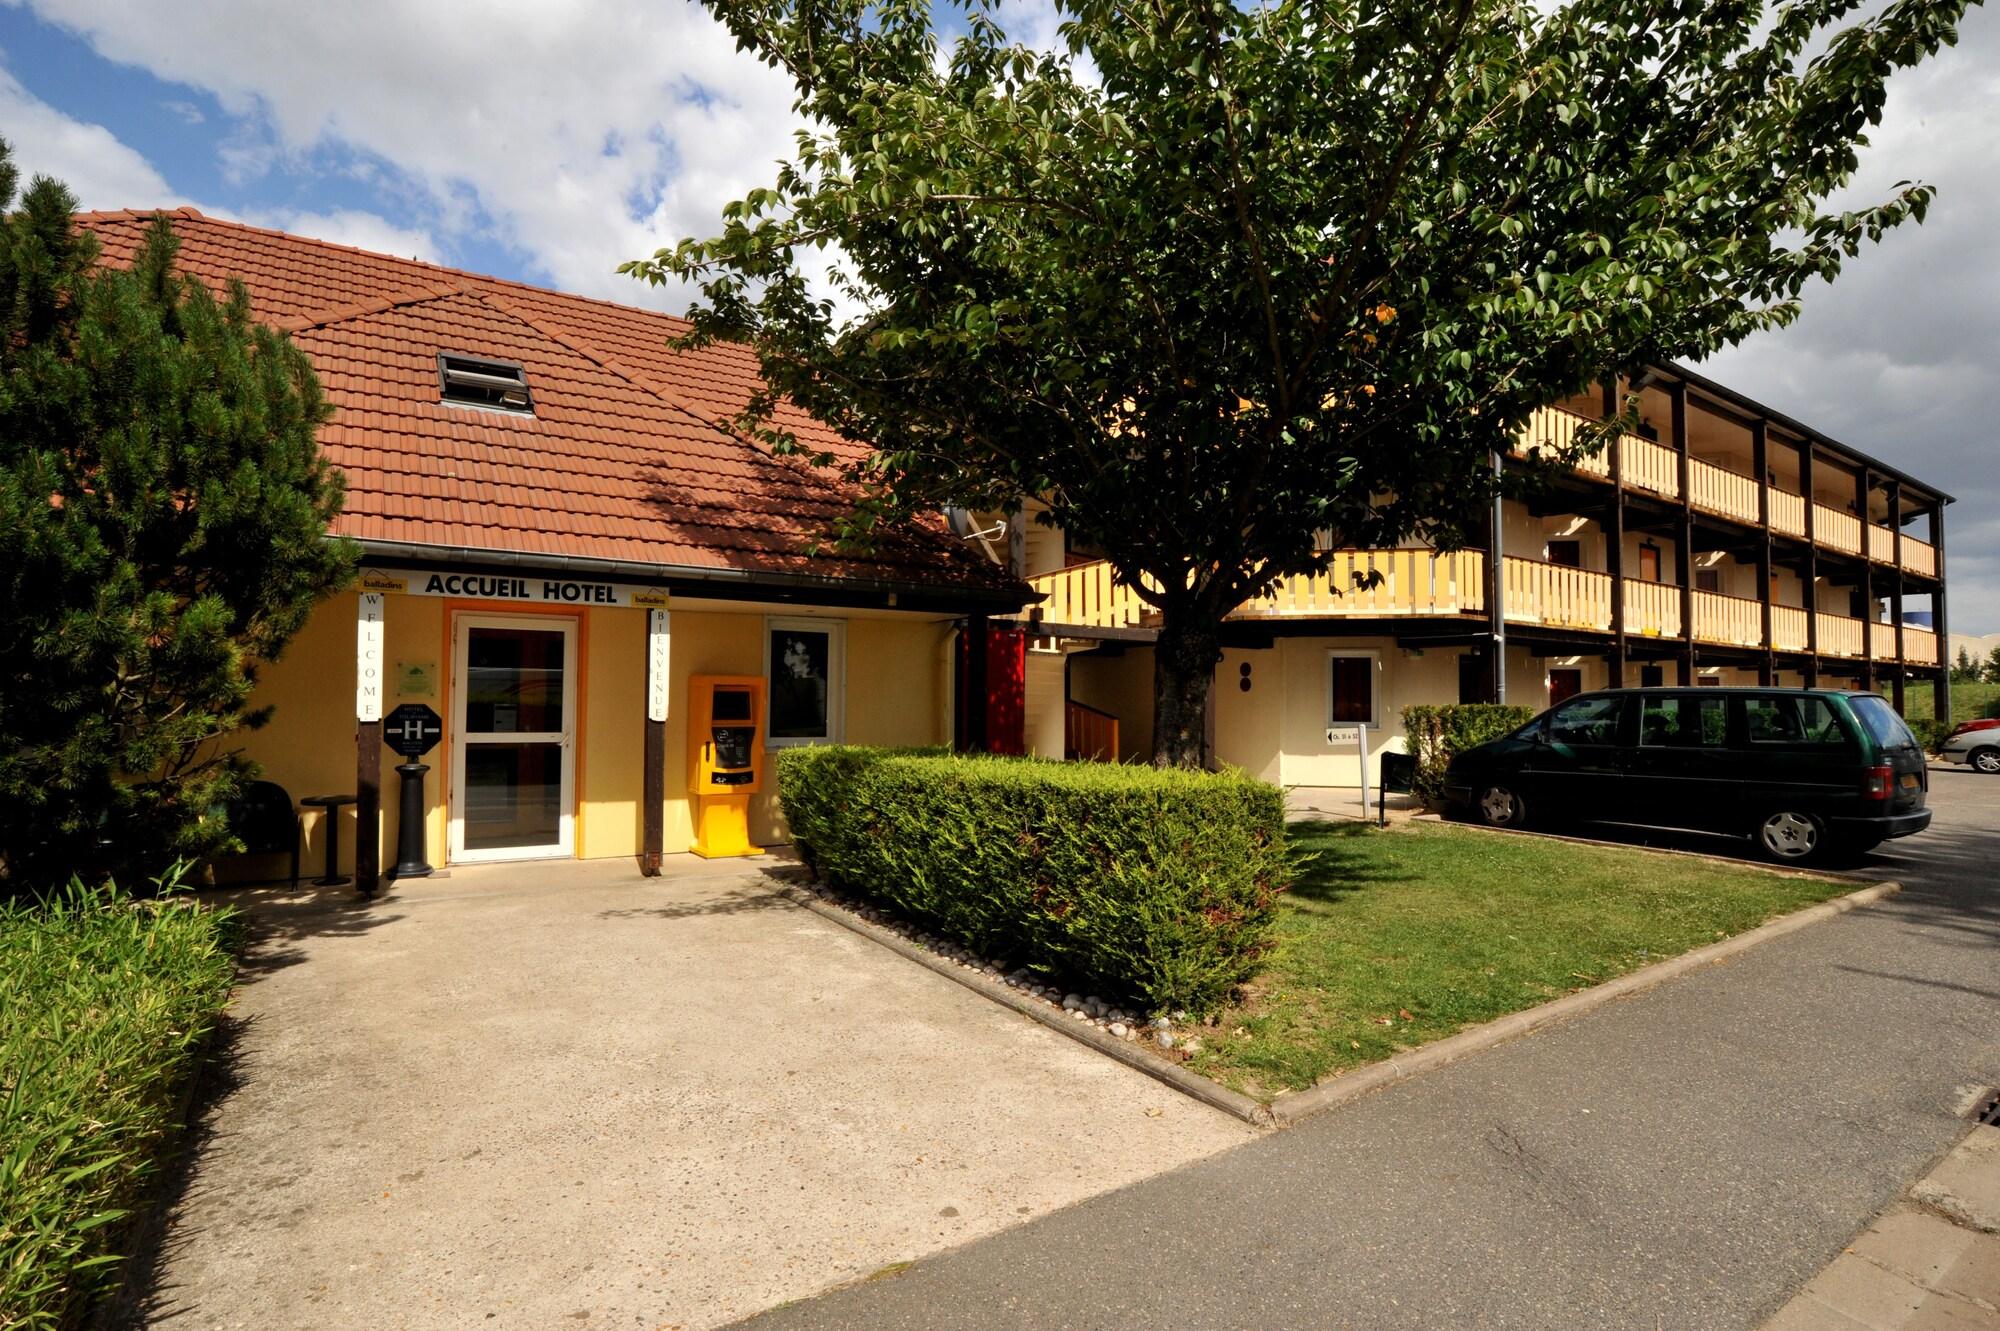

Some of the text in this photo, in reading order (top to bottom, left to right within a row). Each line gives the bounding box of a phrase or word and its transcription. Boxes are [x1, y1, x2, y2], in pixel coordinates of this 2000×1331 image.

[364, 580, 402, 589] balladins
[425, 574, 617, 603] ACCUEIL HOTEL
[363, 595, 379, 715] WELCOME
[655, 611, 665, 717] BIENVENUE
[404, 720, 422, 739] H
